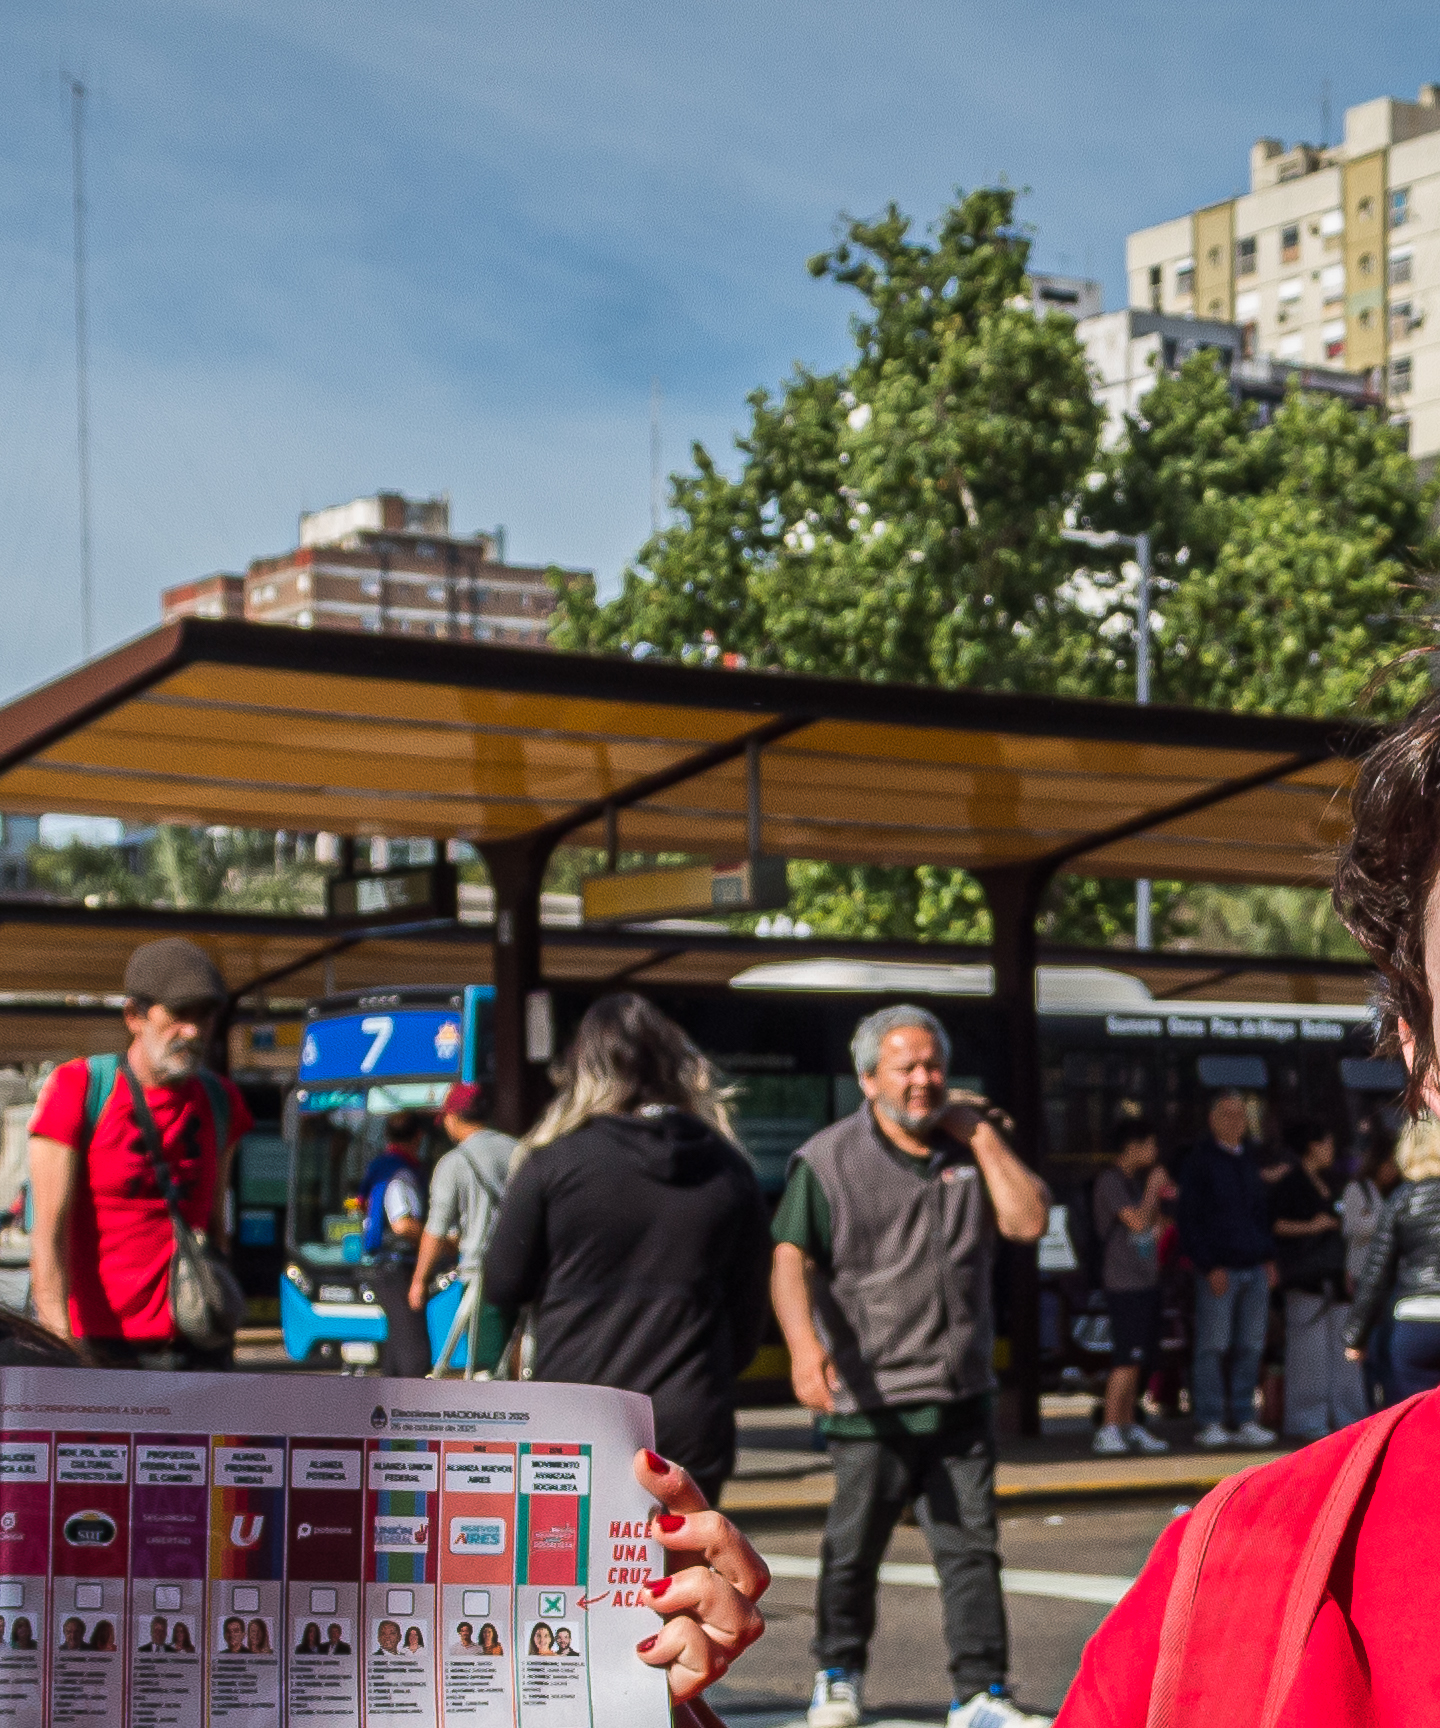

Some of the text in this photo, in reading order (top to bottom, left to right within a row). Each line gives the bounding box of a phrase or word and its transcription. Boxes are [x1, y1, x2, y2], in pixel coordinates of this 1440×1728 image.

[361, 1016, 394, 1074] 7
[609, 1520, 652, 1538] HACE
[612, 1544, 647, 1561] UNA
[607, 1567, 652, 1584] CRUZ
